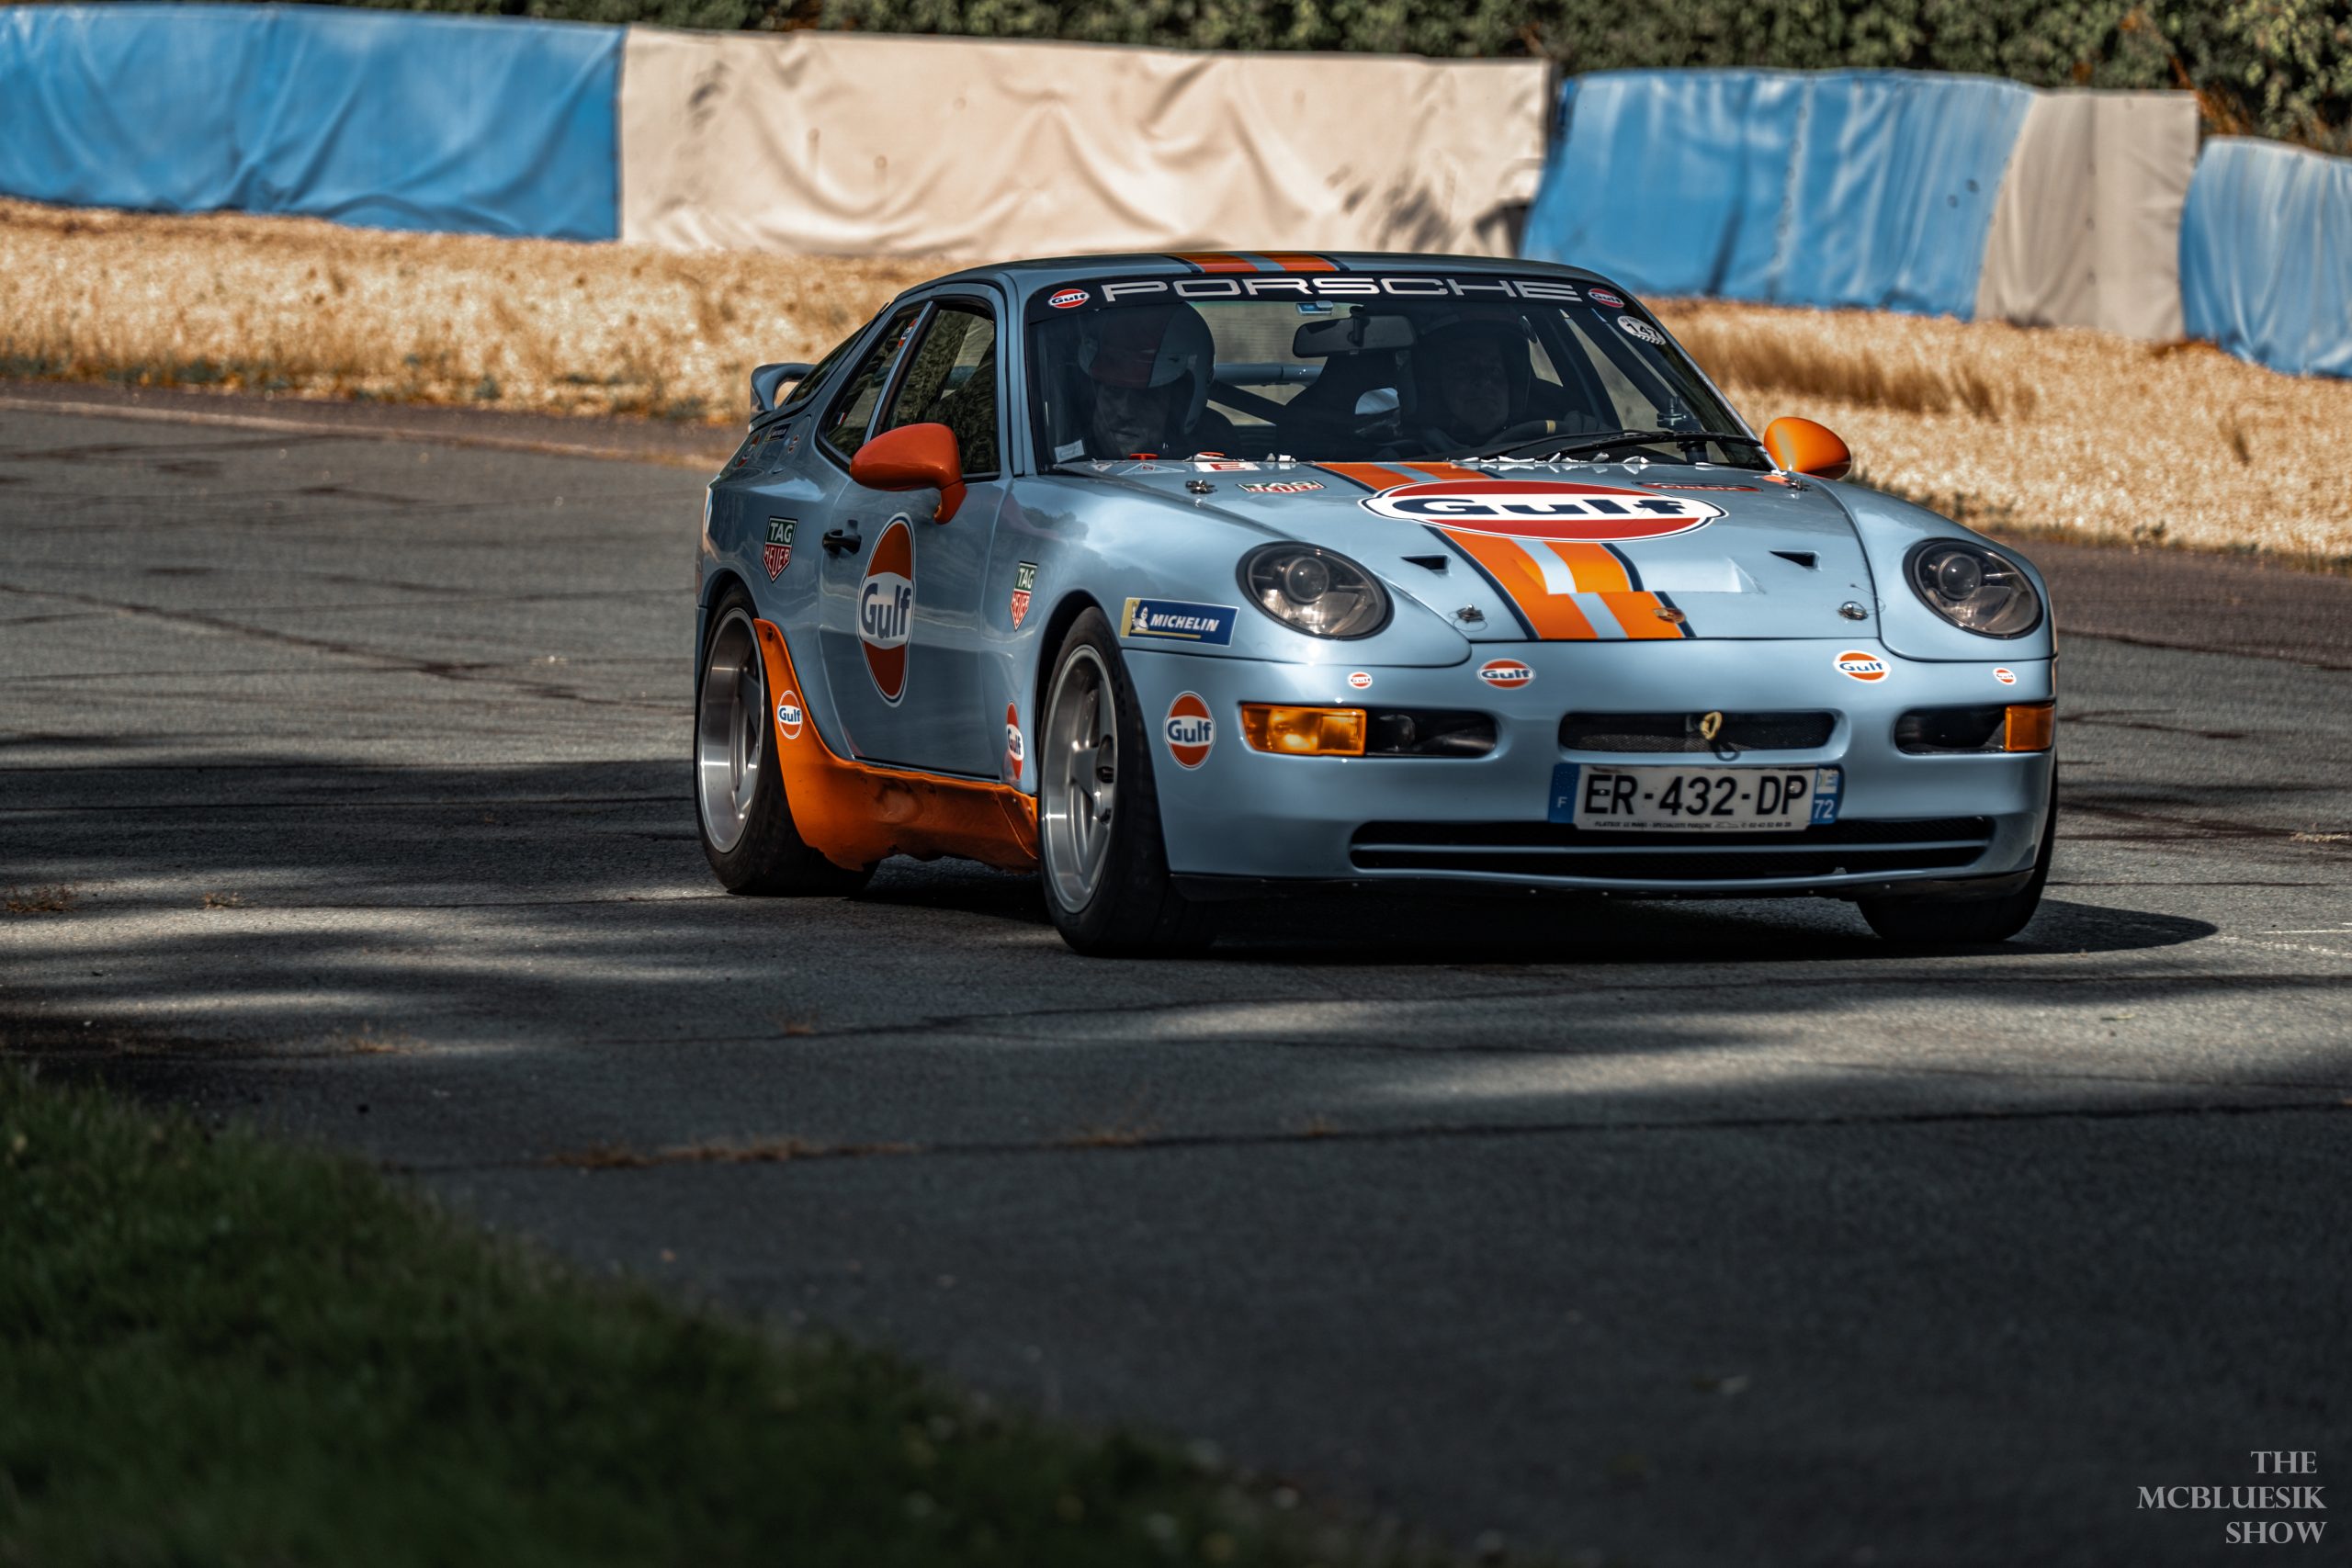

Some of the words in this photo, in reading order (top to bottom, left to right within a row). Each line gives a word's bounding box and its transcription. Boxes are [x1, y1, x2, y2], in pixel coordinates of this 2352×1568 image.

[1051, 294, 1086, 304] Gulf
[1102, 278, 1582, 302] PORSCHE
[1392, 497, 1689, 515] Gulf
[770, 522, 794, 543] TAG
[764, 546, 790, 576] HEUER
[1017, 567, 1035, 590] TAG
[861, 582, 912, 638] Gulf
[1150, 614, 1220, 632] MICHELIN
[1481, 669, 1531, 679] Gulf
[1839, 661, 1883, 671] Gulf
[779, 707, 800, 722] Gulf
[1168, 720, 1213, 742] Gulf
[1557, 795, 1568, 808] F
[1584, 774, 1808, 816] ER-432-DP
[1814, 799, 1835, 818] 72
